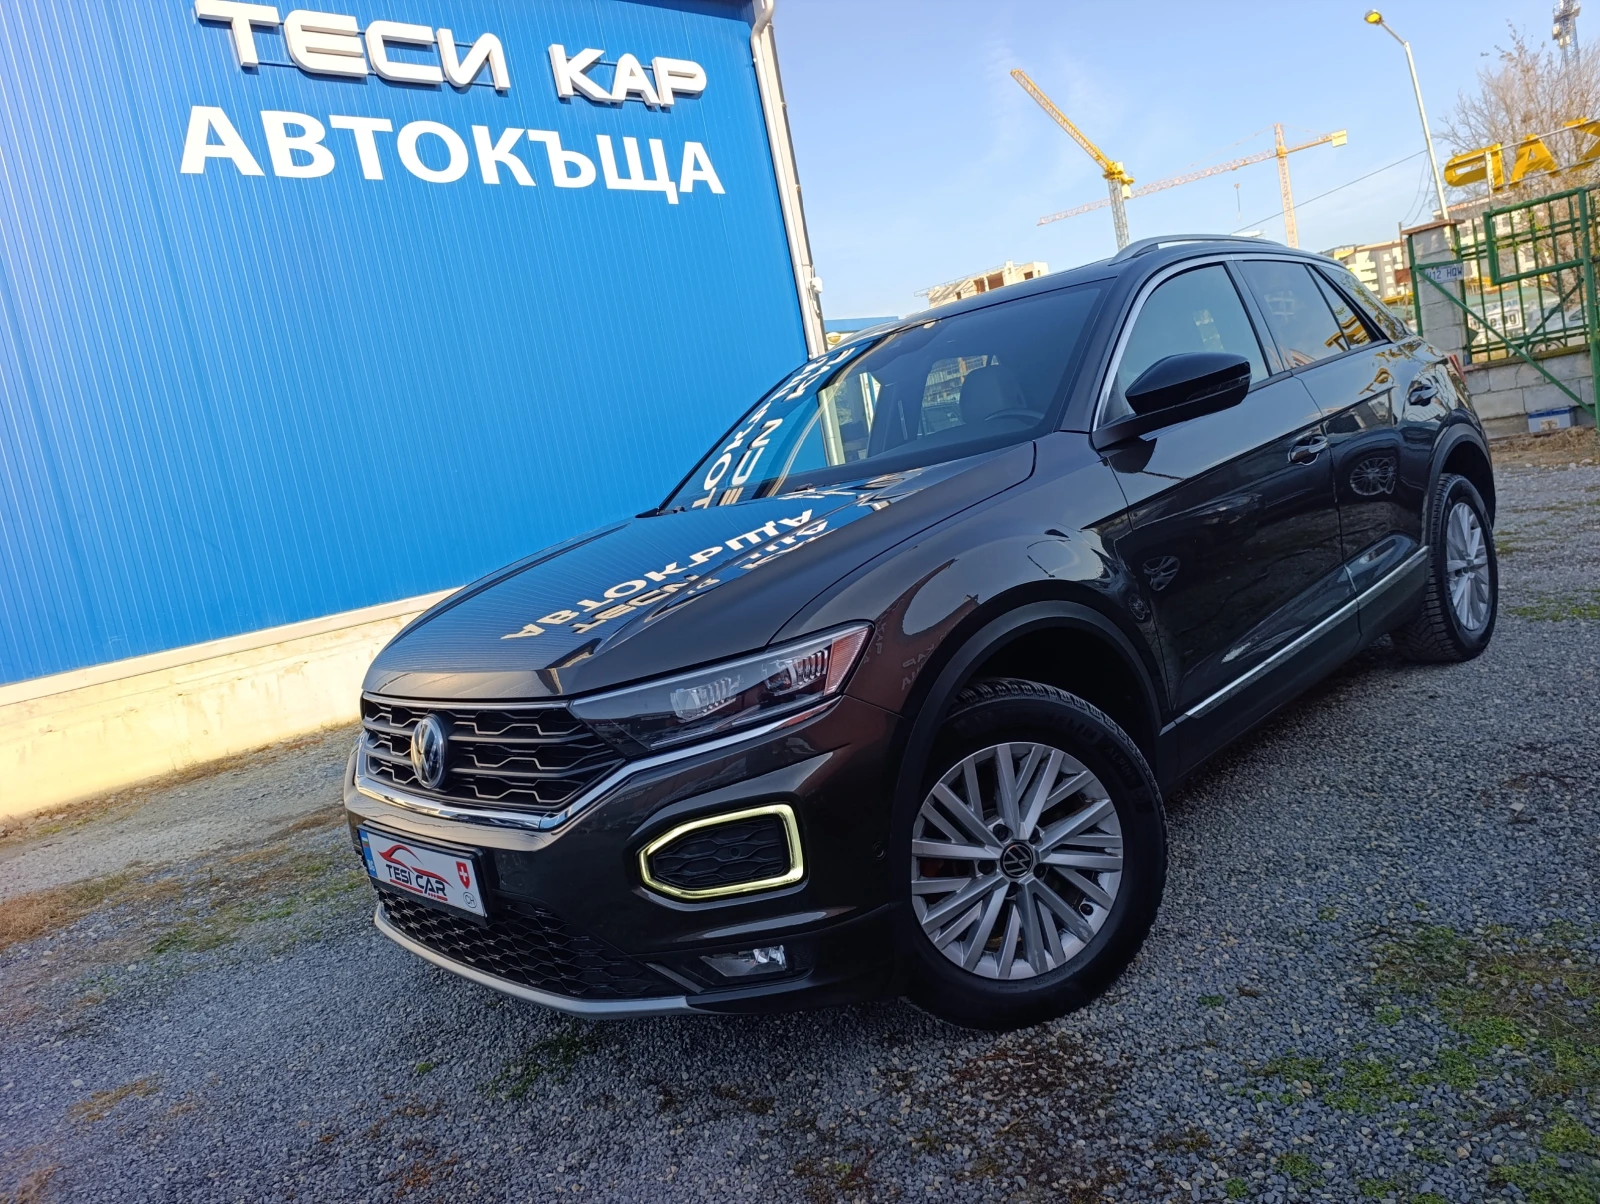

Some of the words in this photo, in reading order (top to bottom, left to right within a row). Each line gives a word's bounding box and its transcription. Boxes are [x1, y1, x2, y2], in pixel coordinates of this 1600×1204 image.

[196, 0, 510, 92] ТЕСИ
[548, 43, 707, 108] КАР
[180, 105, 726, 204] АВТОКЪЩА
[386, 864, 412, 886] TESI
[415, 874, 448, 896] CAR
